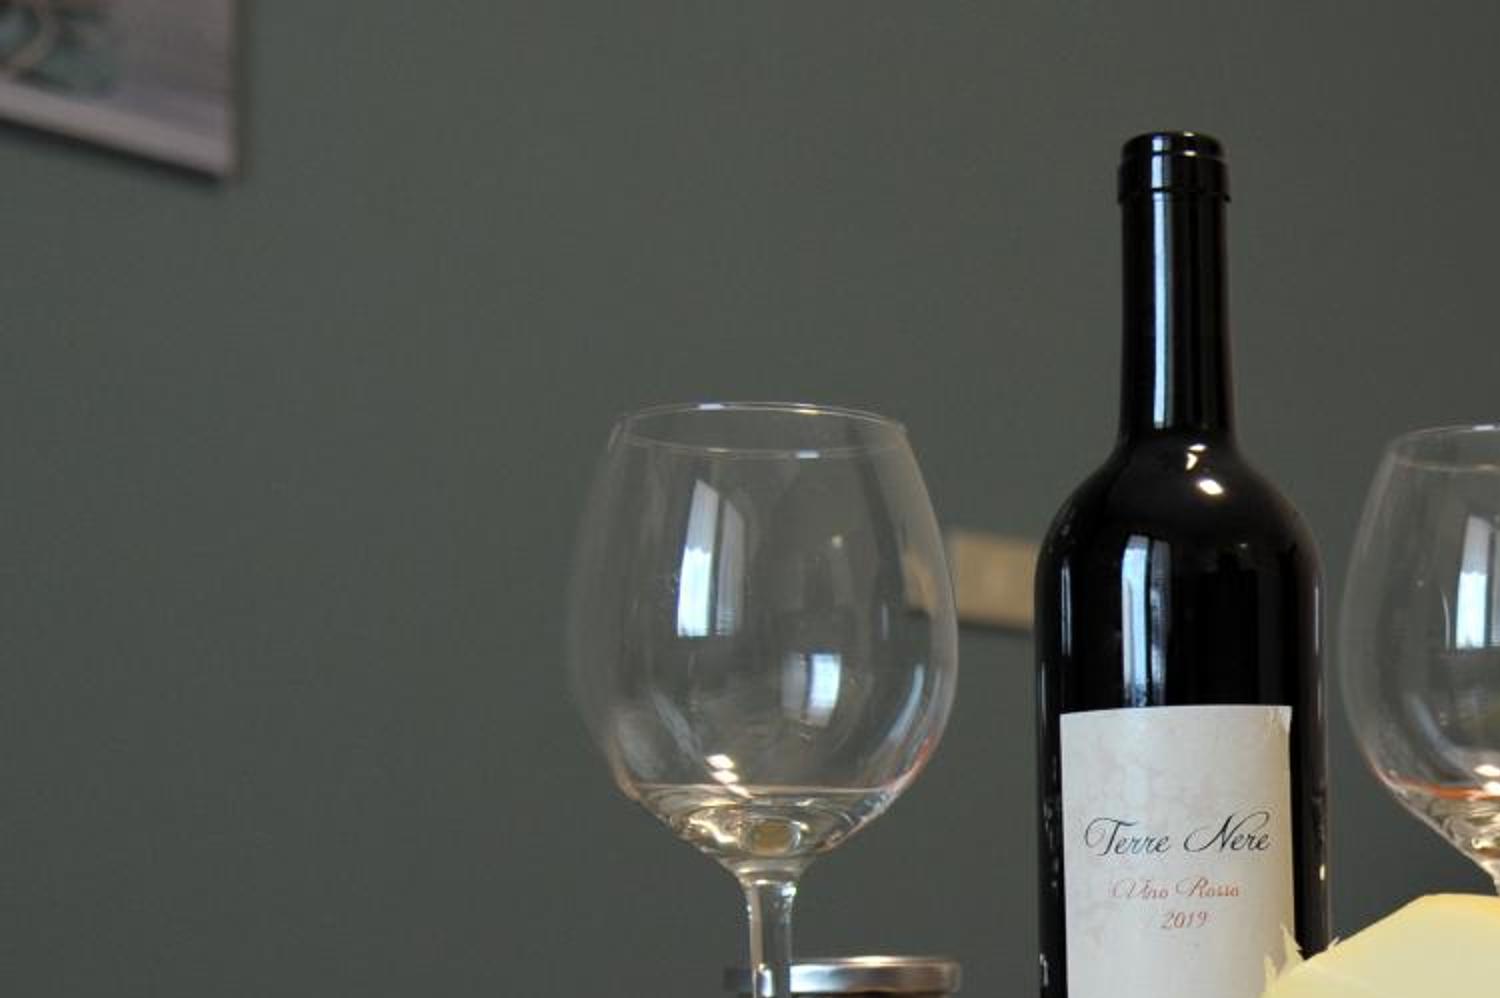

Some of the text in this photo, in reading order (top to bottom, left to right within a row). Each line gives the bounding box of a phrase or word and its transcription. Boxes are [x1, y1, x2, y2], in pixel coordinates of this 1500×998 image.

[1085, 810, 1271, 857] Terre Nere
[1174, 876, 1240, 898] Rosso
[1161, 910, 1208, 930] 2019
